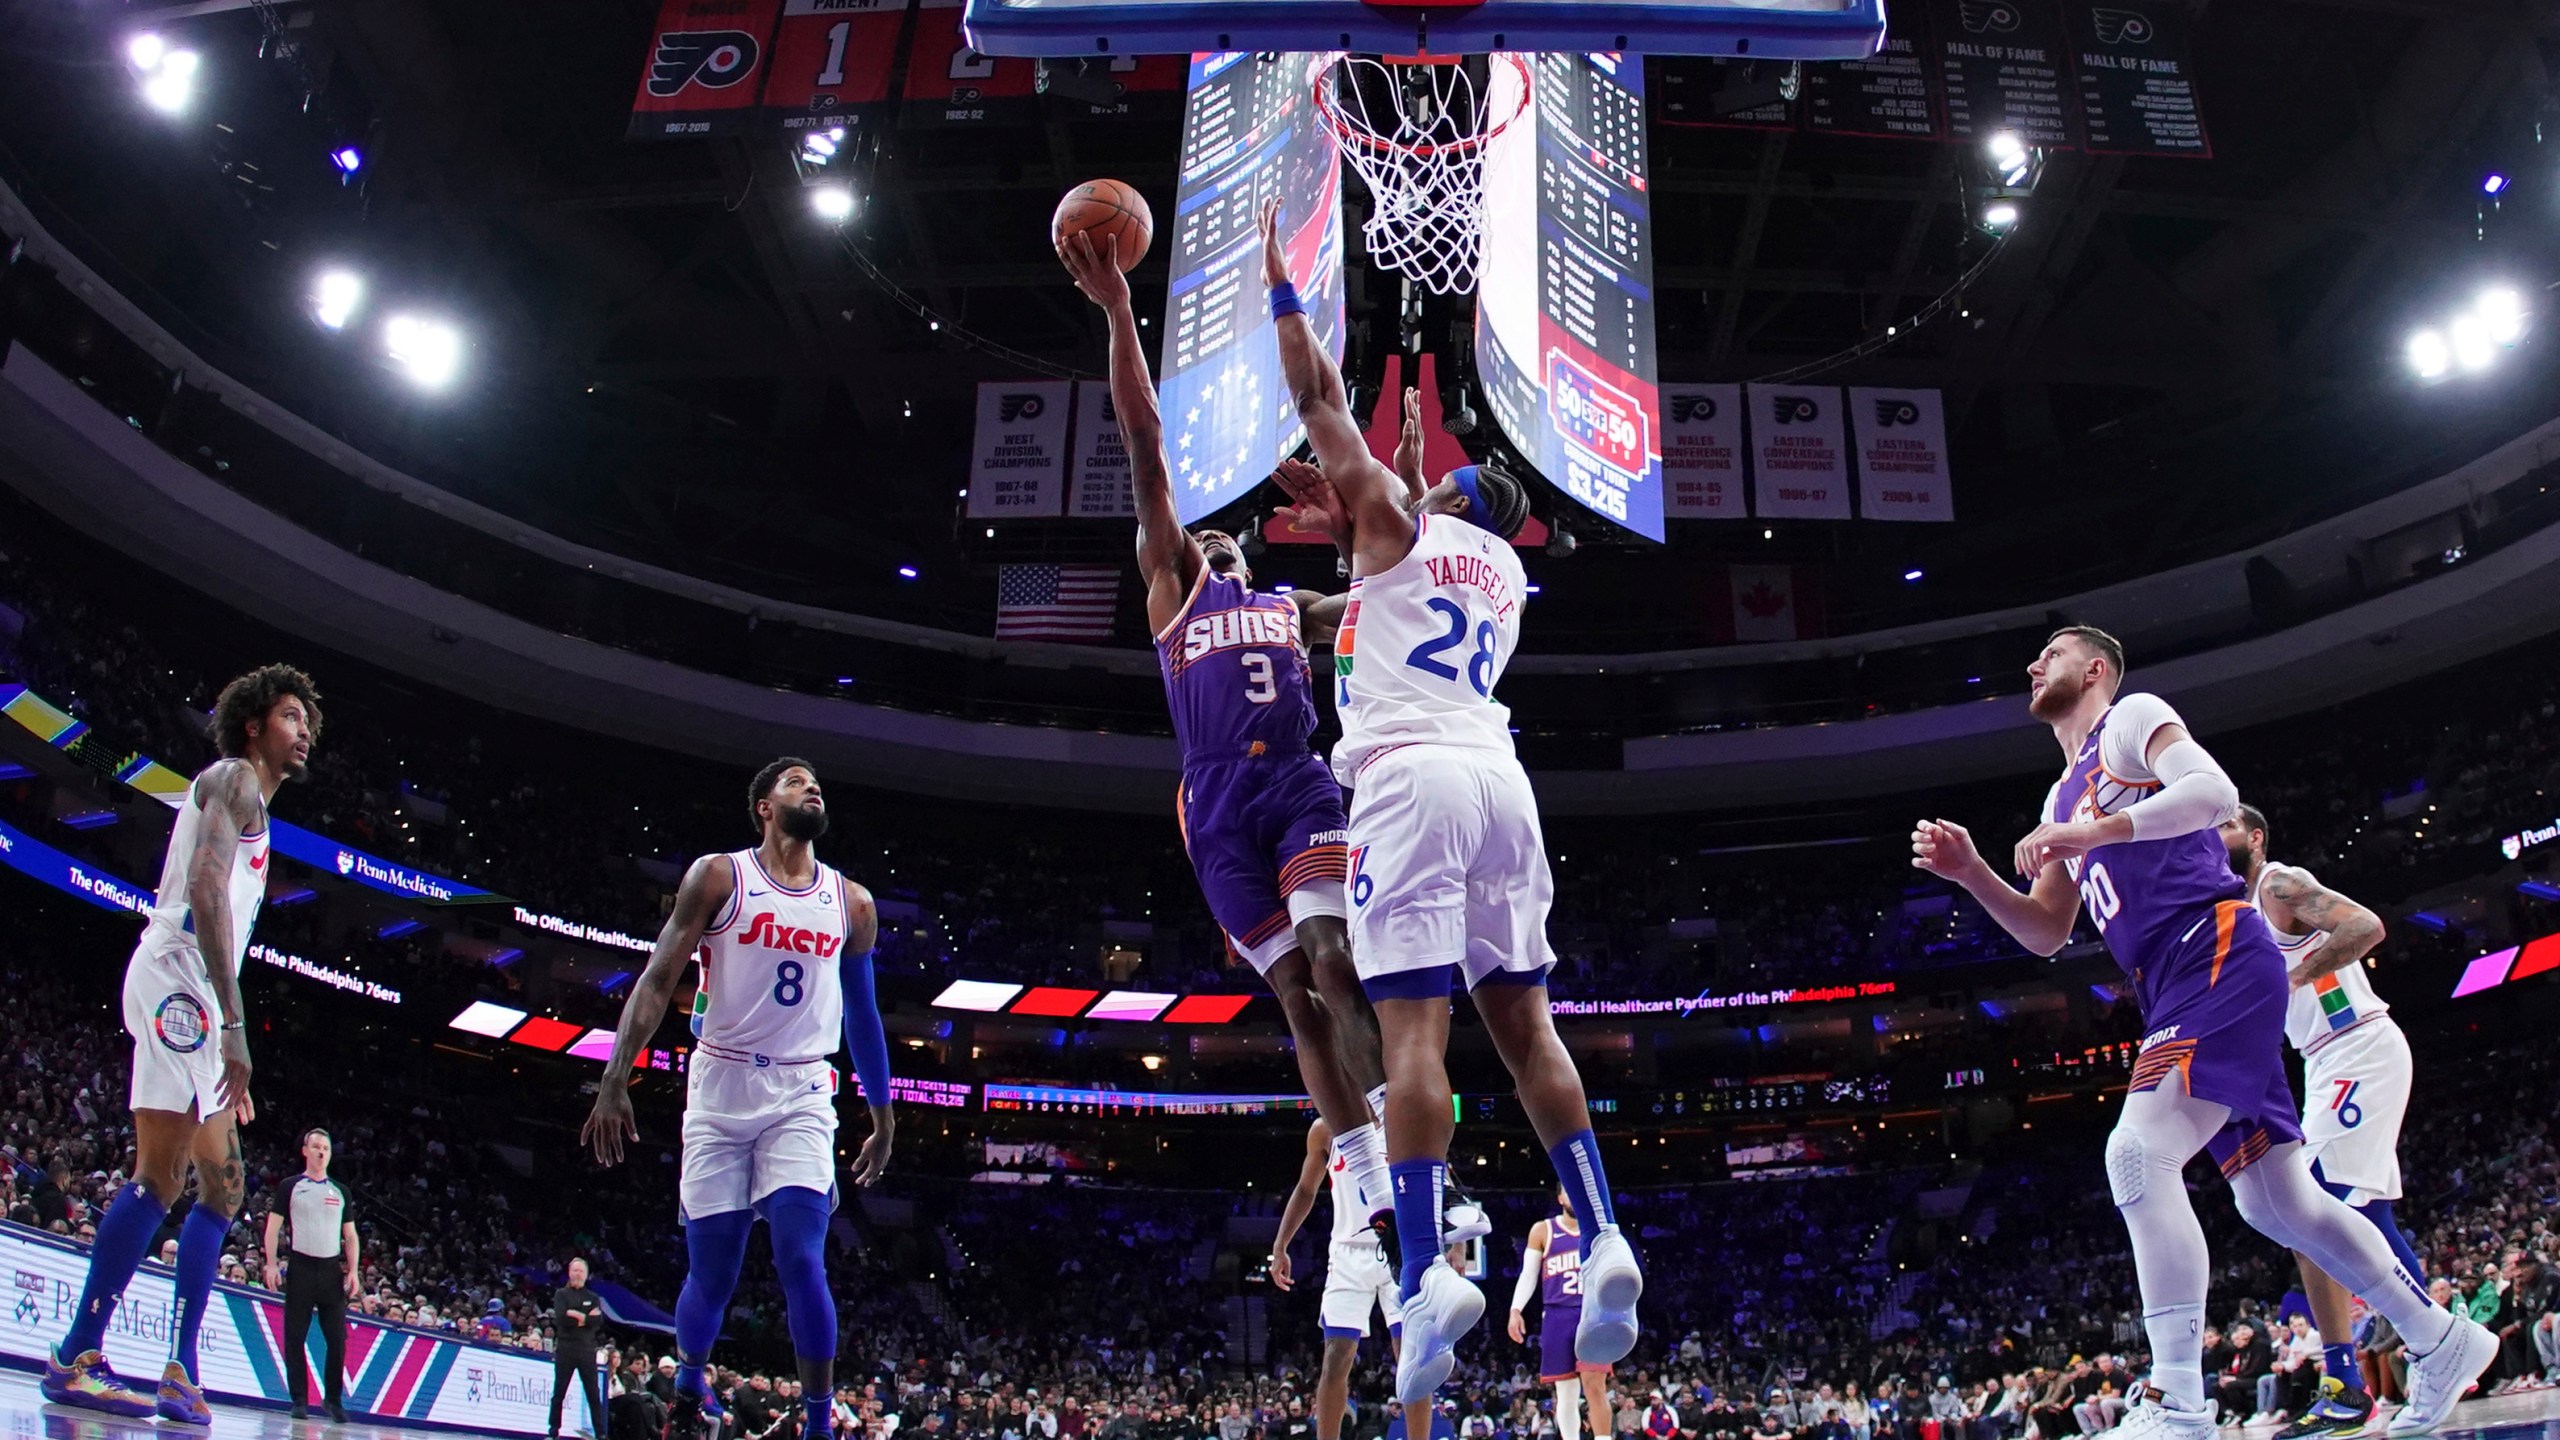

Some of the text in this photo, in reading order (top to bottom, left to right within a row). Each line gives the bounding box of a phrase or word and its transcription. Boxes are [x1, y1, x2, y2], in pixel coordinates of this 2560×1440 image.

[816, 21, 851, 86] 1
[1946, 42, 2047, 63] HALL OF FAME
[2082, 53, 2180, 74] HALL OF FAME
[1567, 158, 1610, 198] TEAM STATS
[1611, 211, 1627, 227] STL
[1564, 237, 1585, 262] TEAM
[1615, 241, 1628, 256] TO
[1564, 256, 1595, 285] DURANT
[1181, 291, 1198, 308] PTS
[1565, 301, 1596, 331] DURANT
[1557, 378, 1581, 418] 50
[1608, 413, 1637, 451] 50
[994, 446, 1044, 458] DIVISION
[1004, 434, 1036, 446] WEST
[1096, 445, 1125, 457] DIVIS
[1677, 435, 1714, 446] WALES
[1773, 436, 1824, 447] EASTERN
[1876, 439, 1926, 451] EASTERN
[984, 457, 1052, 469] CHAMPIONS
[1086, 457, 1131, 469] CHAMPI
[1663, 458, 1731, 470] CHAMPIONS
[1763, 448, 1836, 460] CONFERENCE
[1766, 460, 1834, 472] CHAMPIONS
[1866, 450, 1937, 462] CONFERENCE
[1603, 466, 1631, 491] TOTAL
[1869, 462, 1936, 474] CHAMPIONS
[1567, 461, 1628, 521] $3,215
[1425, 554, 1515, 624] YABUSELE
[1184, 609, 1290, 661] SUNS
[1406, 597, 1497, 700] 28
[1240, 652, 1279, 704] 3
[1309, 829, 1349, 847] PHOEN
[2521, 825, 2557, 849] Penn
[70, 866, 93, 892] The
[93, 880, 137, 911] Official
[357, 856, 453, 902] Penn Medicine
[1349, 844, 1374, 908] 76
[2080, 861, 2122, 936] 20
[514, 905, 657, 954] The Official Healthcare
[738, 911, 842, 959] Sixers
[249, 943, 401, 1004] of the Philadelphia 76ers
[773, 960, 804, 1007] 8
[1549, 982, 1896, 1015] Official Healthcare Partner of the Philadelphia 76ers
[653, 1049, 670, 1061] PHI
[902, 1089, 933, 1104] TOTAL:
[1041, 1102, 1049, 1112] 0
[2330, 1078, 2362, 1129] 76
[1547, 1250, 1581, 1277] SUN
[487, 1370, 519, 1402] Penn
